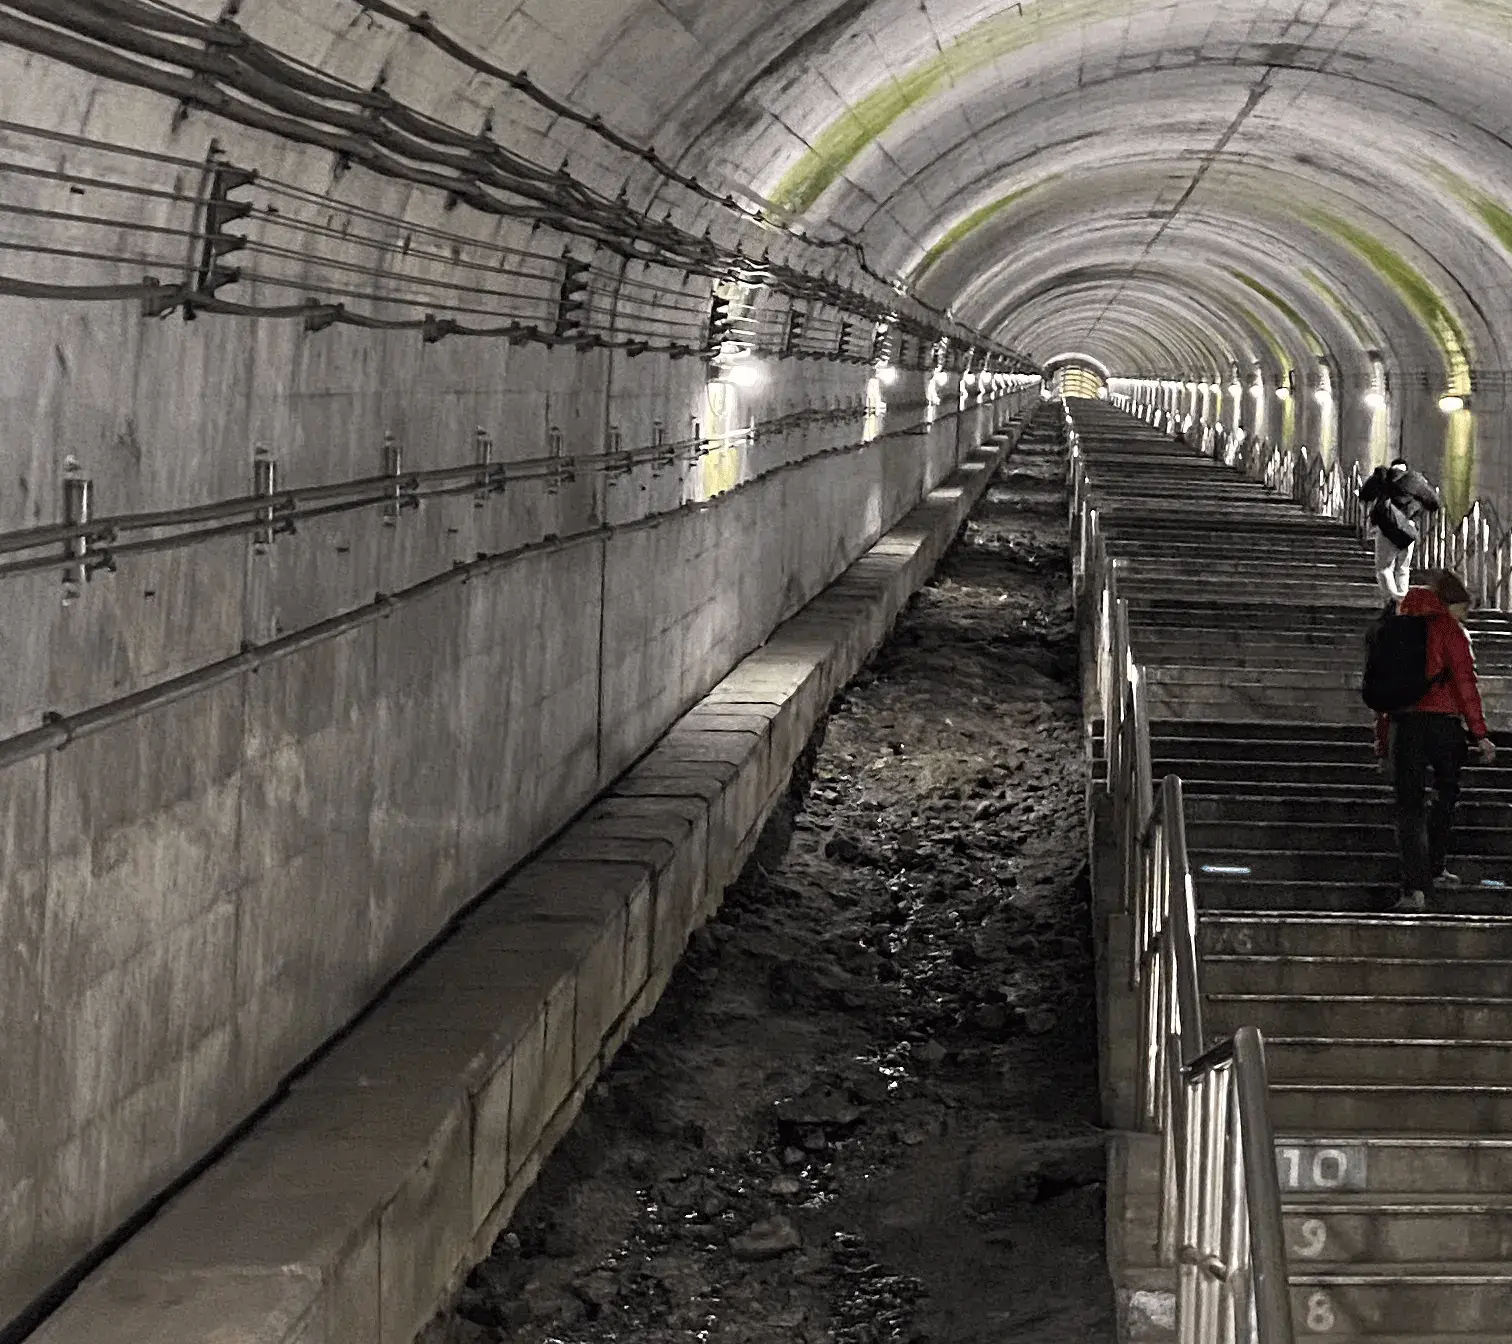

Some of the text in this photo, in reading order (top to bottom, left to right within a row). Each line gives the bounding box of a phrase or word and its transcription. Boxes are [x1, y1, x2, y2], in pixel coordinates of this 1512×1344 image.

[1283, 1149, 1347, 1188] 10
[1293, 1218, 1327, 1257] 9
[1307, 1291, 1335, 1332] 8
